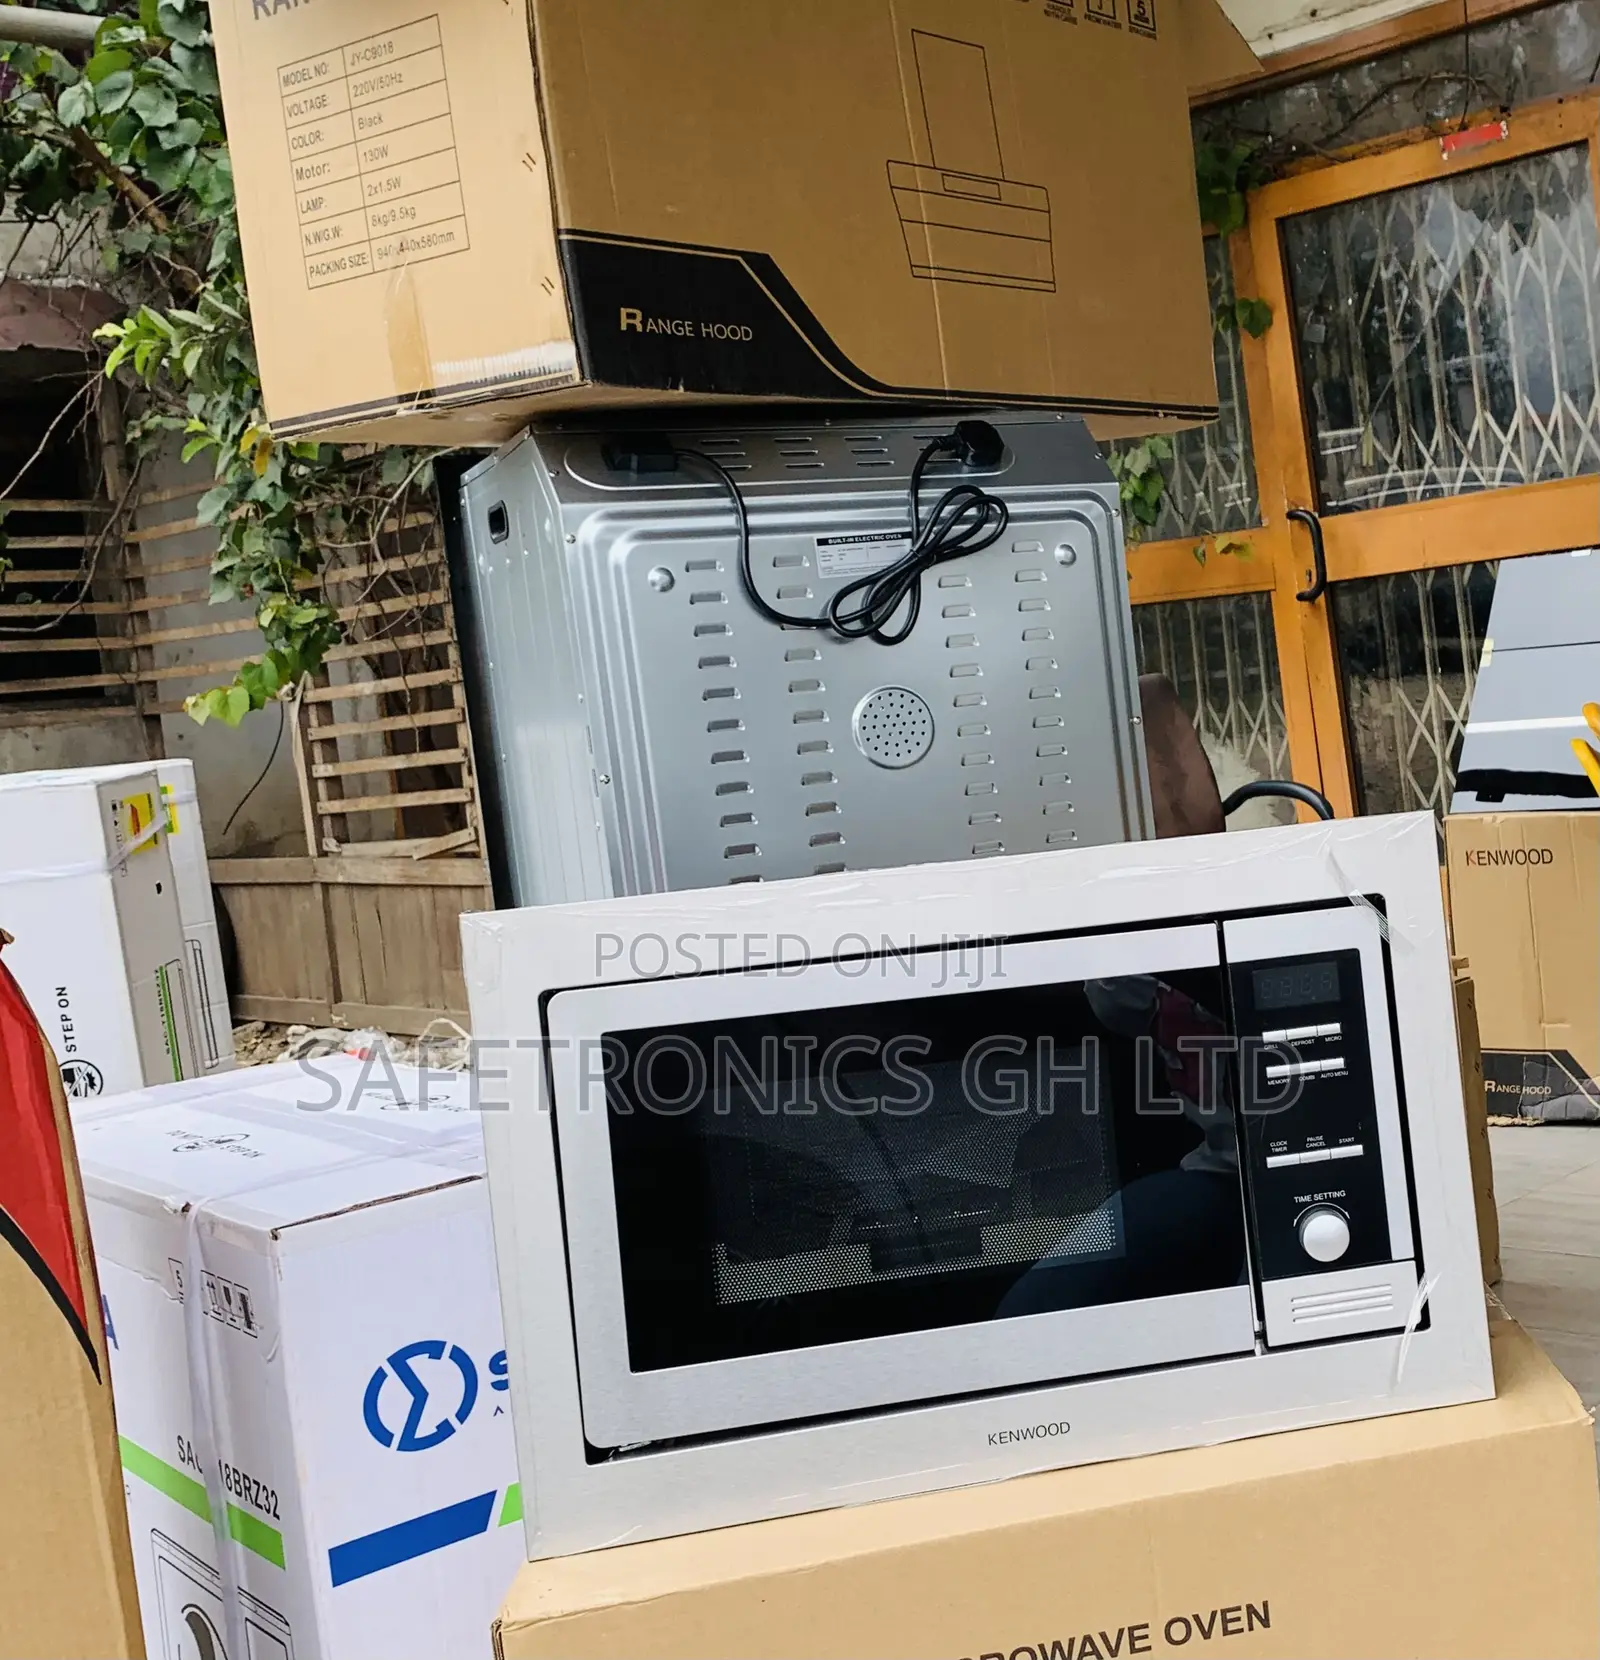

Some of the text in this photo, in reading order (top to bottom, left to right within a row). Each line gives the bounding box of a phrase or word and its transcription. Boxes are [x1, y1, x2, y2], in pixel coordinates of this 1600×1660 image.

[350, 41, 394, 66] JY-C9018
[282, 61, 330, 88] MODEL NO:
[352, 73, 403, 97] 220V/50Hz
[286, 94, 330, 118] VOLTAGE:
[358, 112, 383, 130] Black
[291, 130, 324, 150] COLOR:
[363, 145, 389, 163] 130W
[295, 162, 331, 181] Motor:
[367, 176, 402, 197] 2x1.5W
[300, 196, 327, 214] LAMP:
[309, 252, 370, 278] PACKING SIZE:
[619, 307, 753, 342] RANGE HOOD
[856, 533, 885, 542] ELECTRIC
[1465, 848, 1553, 866] KENWOOD
[55, 986, 77, 1053] STEP ON
[1291, 1038, 1315, 1047] DEFROST
[1267, 1078, 1290, 1086] MEMORY
[1522, 1085, 1552, 1095] HOOD
[1270, 1140, 1288, 1148] CLOCK
[1305, 1141, 1326, 1149] CANCEL
[1294, 1190, 1346, 1203] TIME SETTING
[987, 1420, 1071, 1447] KENWOOD
[1164, 1599, 1272, 1647] OVEN
